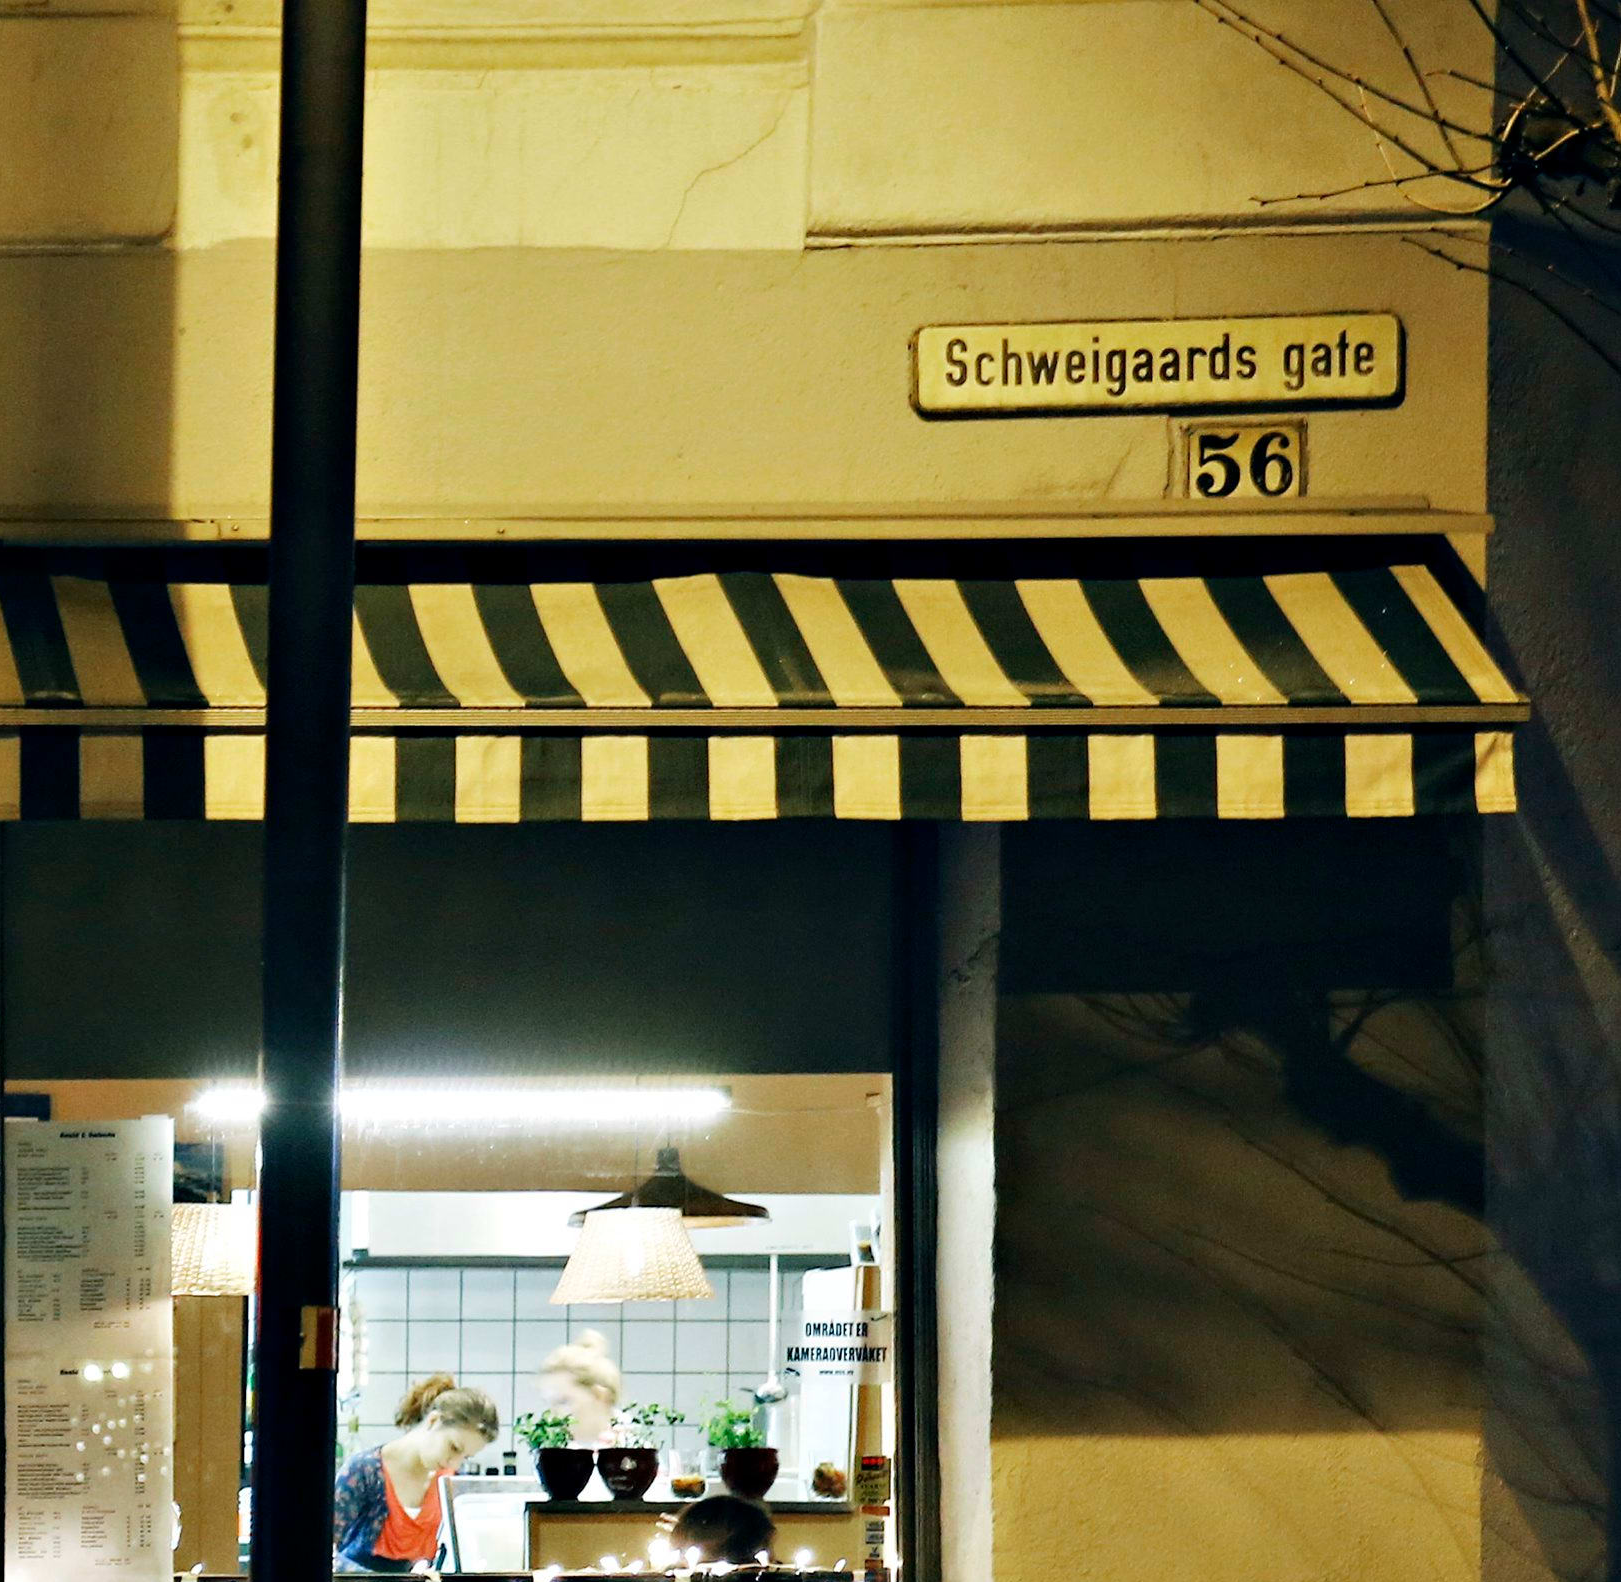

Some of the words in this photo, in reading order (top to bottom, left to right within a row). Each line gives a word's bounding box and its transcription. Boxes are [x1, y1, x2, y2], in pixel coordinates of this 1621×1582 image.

[944, 333, 1258, 398] Schweigaards
[1282, 330, 1376, 391] gate
[1195, 431, 1294, 498] 56
[805, 1319, 854, 1337] OMRÅDET
[856, 1322, 868, 1337] ER
[787, 1343, 887, 1362] KAMERAOVERVÅKET
